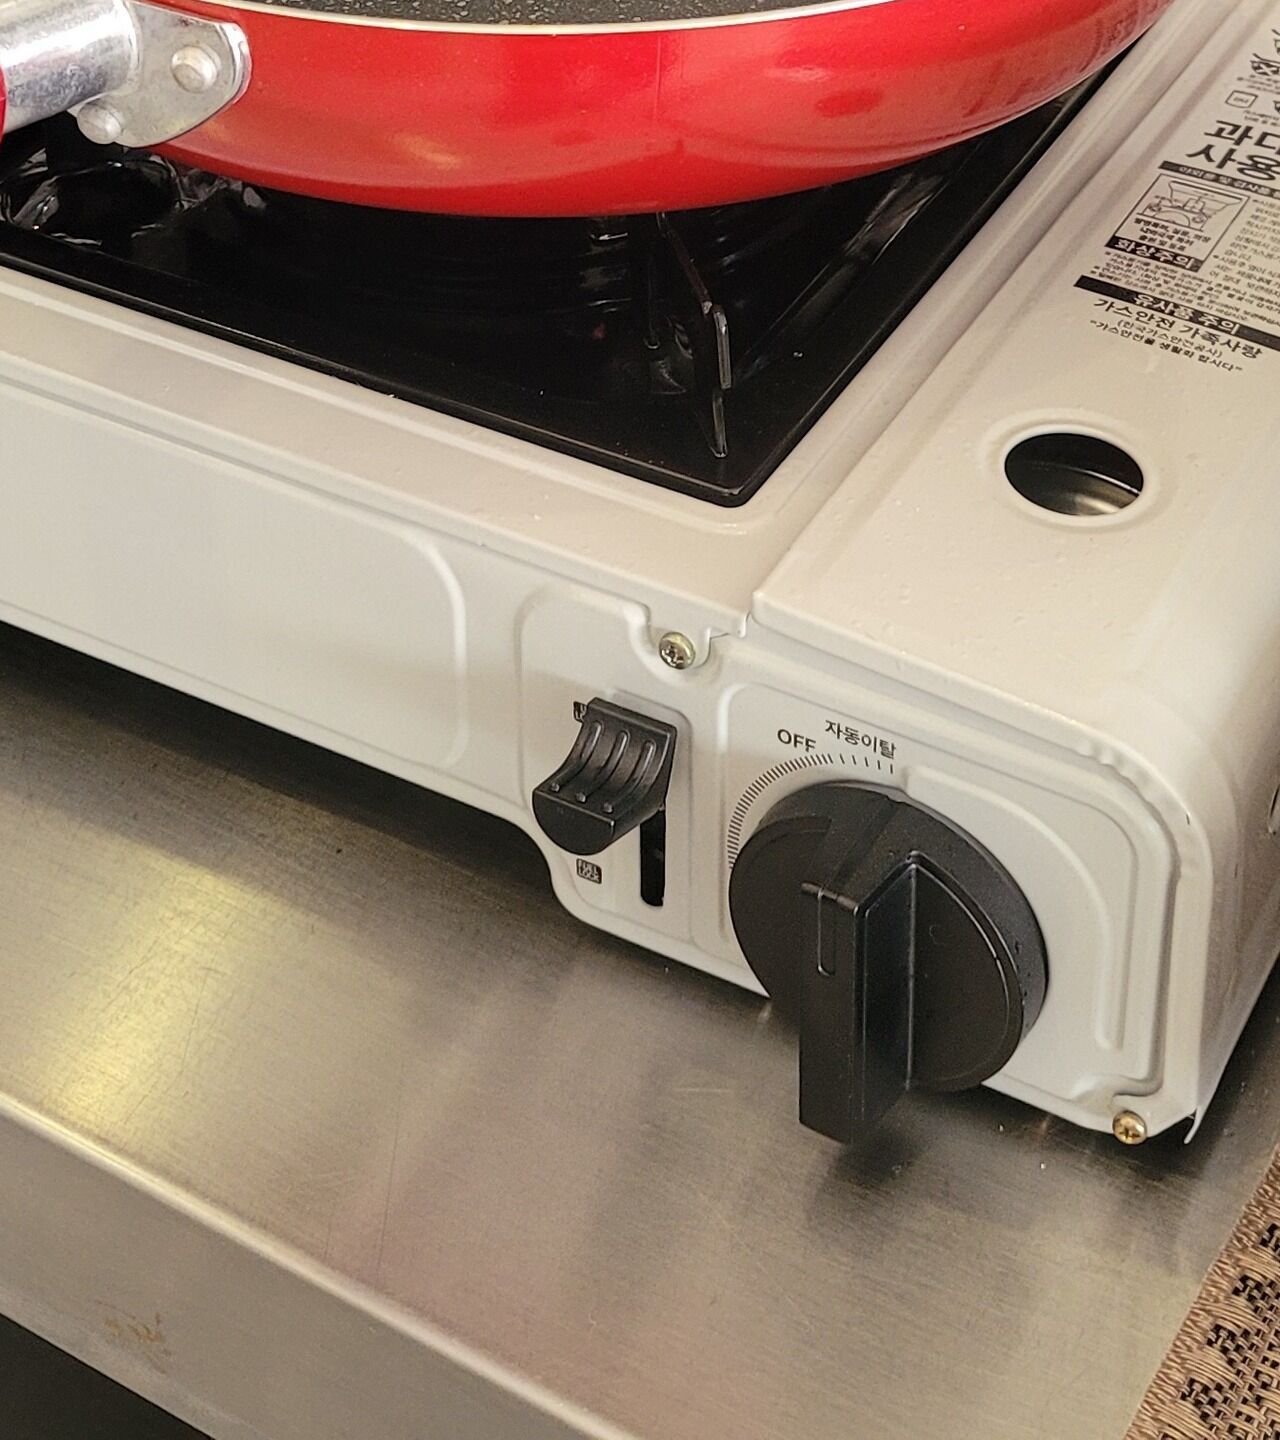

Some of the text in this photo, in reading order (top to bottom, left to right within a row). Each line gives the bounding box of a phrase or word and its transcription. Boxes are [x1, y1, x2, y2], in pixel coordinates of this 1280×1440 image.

[1115, 236, 1195, 269] 화상주의
[1093, 298, 1263, 359] 가스안전 가족사랑
[1134, 294, 1240, 335] 유사품 주의
[777, 728, 817, 753] OFF
[825, 719, 897, 760] 자동이탈
